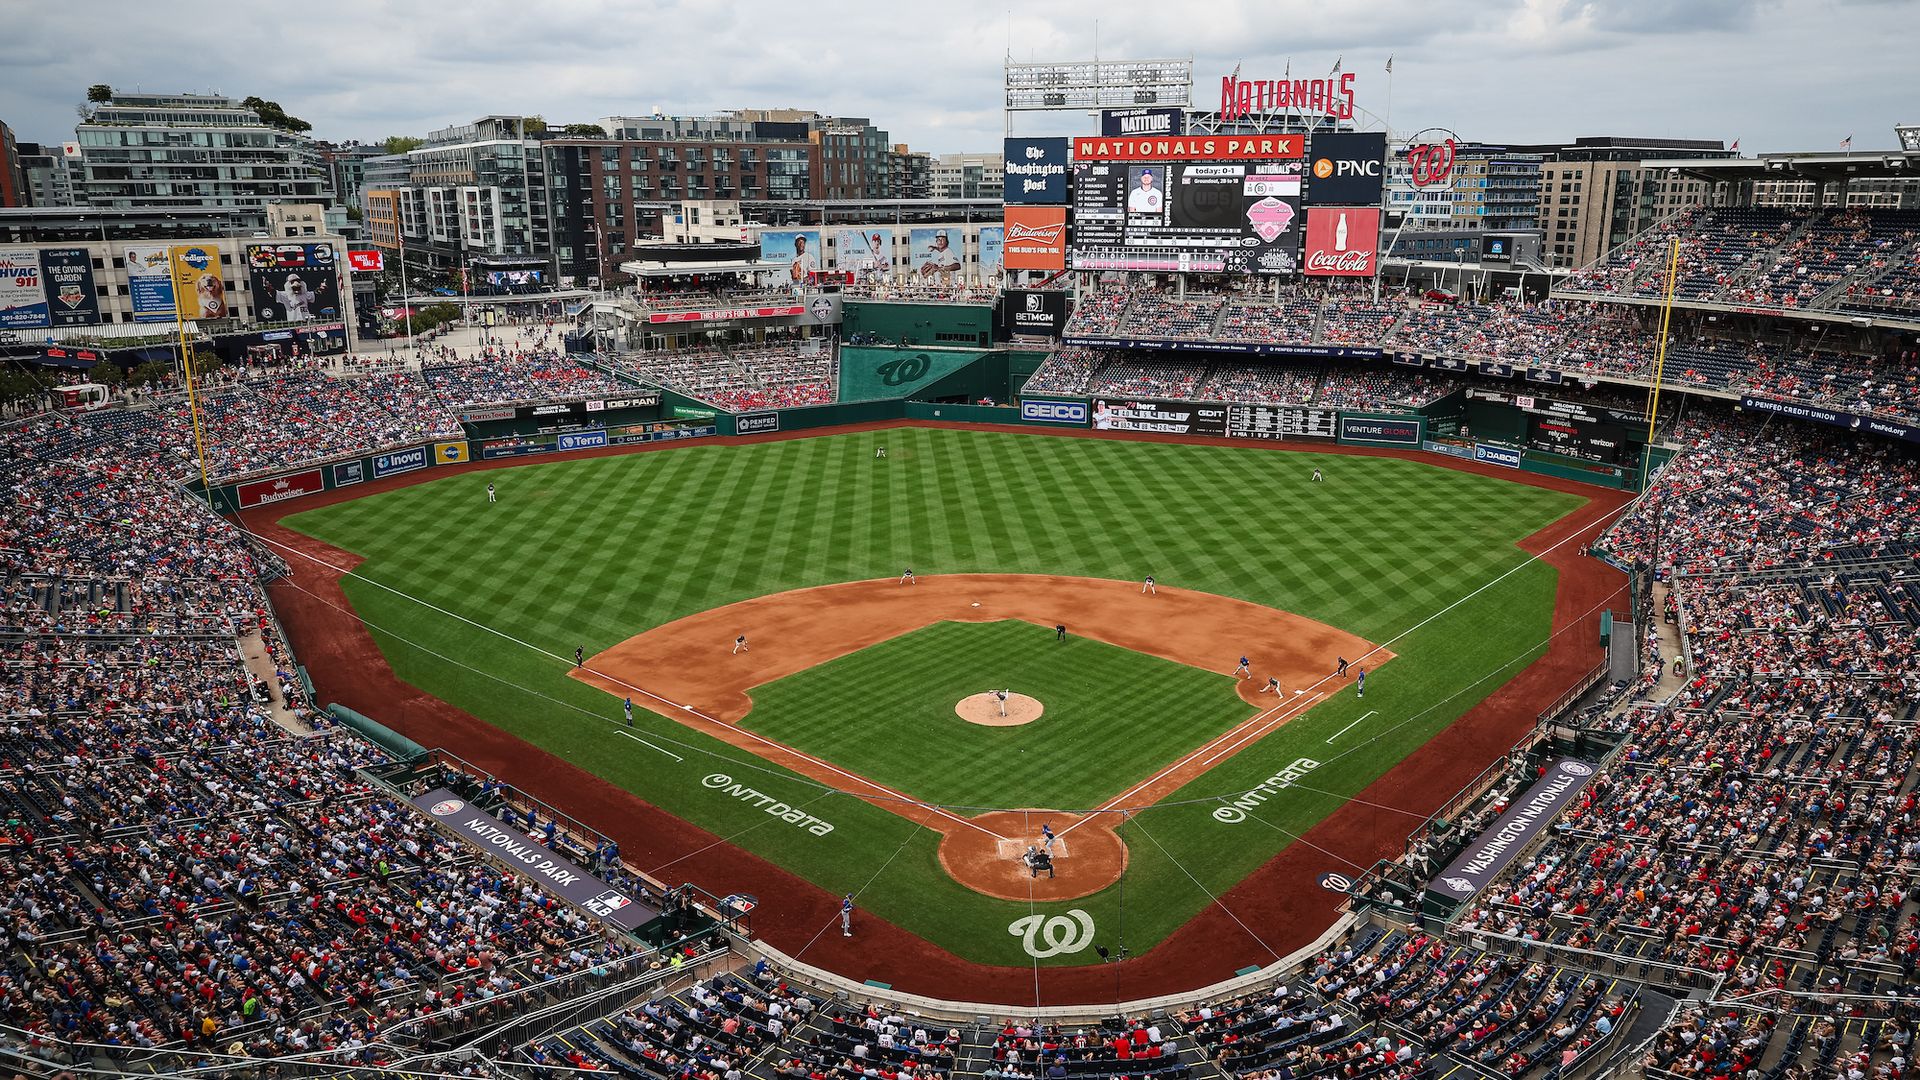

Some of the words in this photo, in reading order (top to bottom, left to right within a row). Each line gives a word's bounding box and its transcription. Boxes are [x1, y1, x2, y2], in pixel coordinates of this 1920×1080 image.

[1221, 73, 1355, 122] NATIONALS
[1121, 114, 1171, 132] NATITUDE
[1025, 146, 1045, 159] The
[1081, 142, 1216, 156] NATIONALS
[1228, 140, 1291, 154] PARK
[1006, 160, 1065, 177] Washington
[1092, 166, 1109, 175] CUBS
[1255, 165, 1290, 175] NATIONALS
[1336, 160, 1380, 177] PNC
[1023, 179, 1047, 194] Post
[1165, 165, 1173, 199] michael
[1164, 201, 1172, 226] busch
[1008, 226, 1060, 238] Budweiser
[179, 254, 214, 263] Pedigree
[1308, 250, 1373, 272] Coca-Cola
[0, 268, 37, 277] HVAC
[48, 266, 60, 274] THE
[16, 277, 37, 287] 911
[55, 274, 82, 282] GARDEN
[700, 312, 713, 320] THIS
[734, 310, 745, 318] FOR
[1016, 312, 1053, 321] BETMGM
[632, 398, 656, 406] FAN
[1136, 402, 1156, 410] herz
[1024, 405, 1086, 420] GEICO
[1549, 406, 1574, 414] NATIONALS
[1754, 401, 1782, 412] PENFED
[1783, 405, 1809, 416] CREDIT
[1811, 411, 1836, 421] UNION
[749, 418, 776, 426] PENFED
[1347, 425, 1382, 434] VENTURE
[1383, 428, 1413, 437] GLOBAL
[574, 434, 603, 447] Terra
[1590, 438, 1615, 448] verizon
[391, 452, 422, 466] Inova
[1487, 452, 1518, 462] DABOS
[260, 488, 304, 502] Budweiser
[1461, 816, 1531, 875] WASHINGTON
[1522, 774, 1575, 819] NATIONALS
[464, 817, 542, 865] NATIONALS
[534, 859, 580, 888] PARK
[582, 898, 612, 917] MLB
